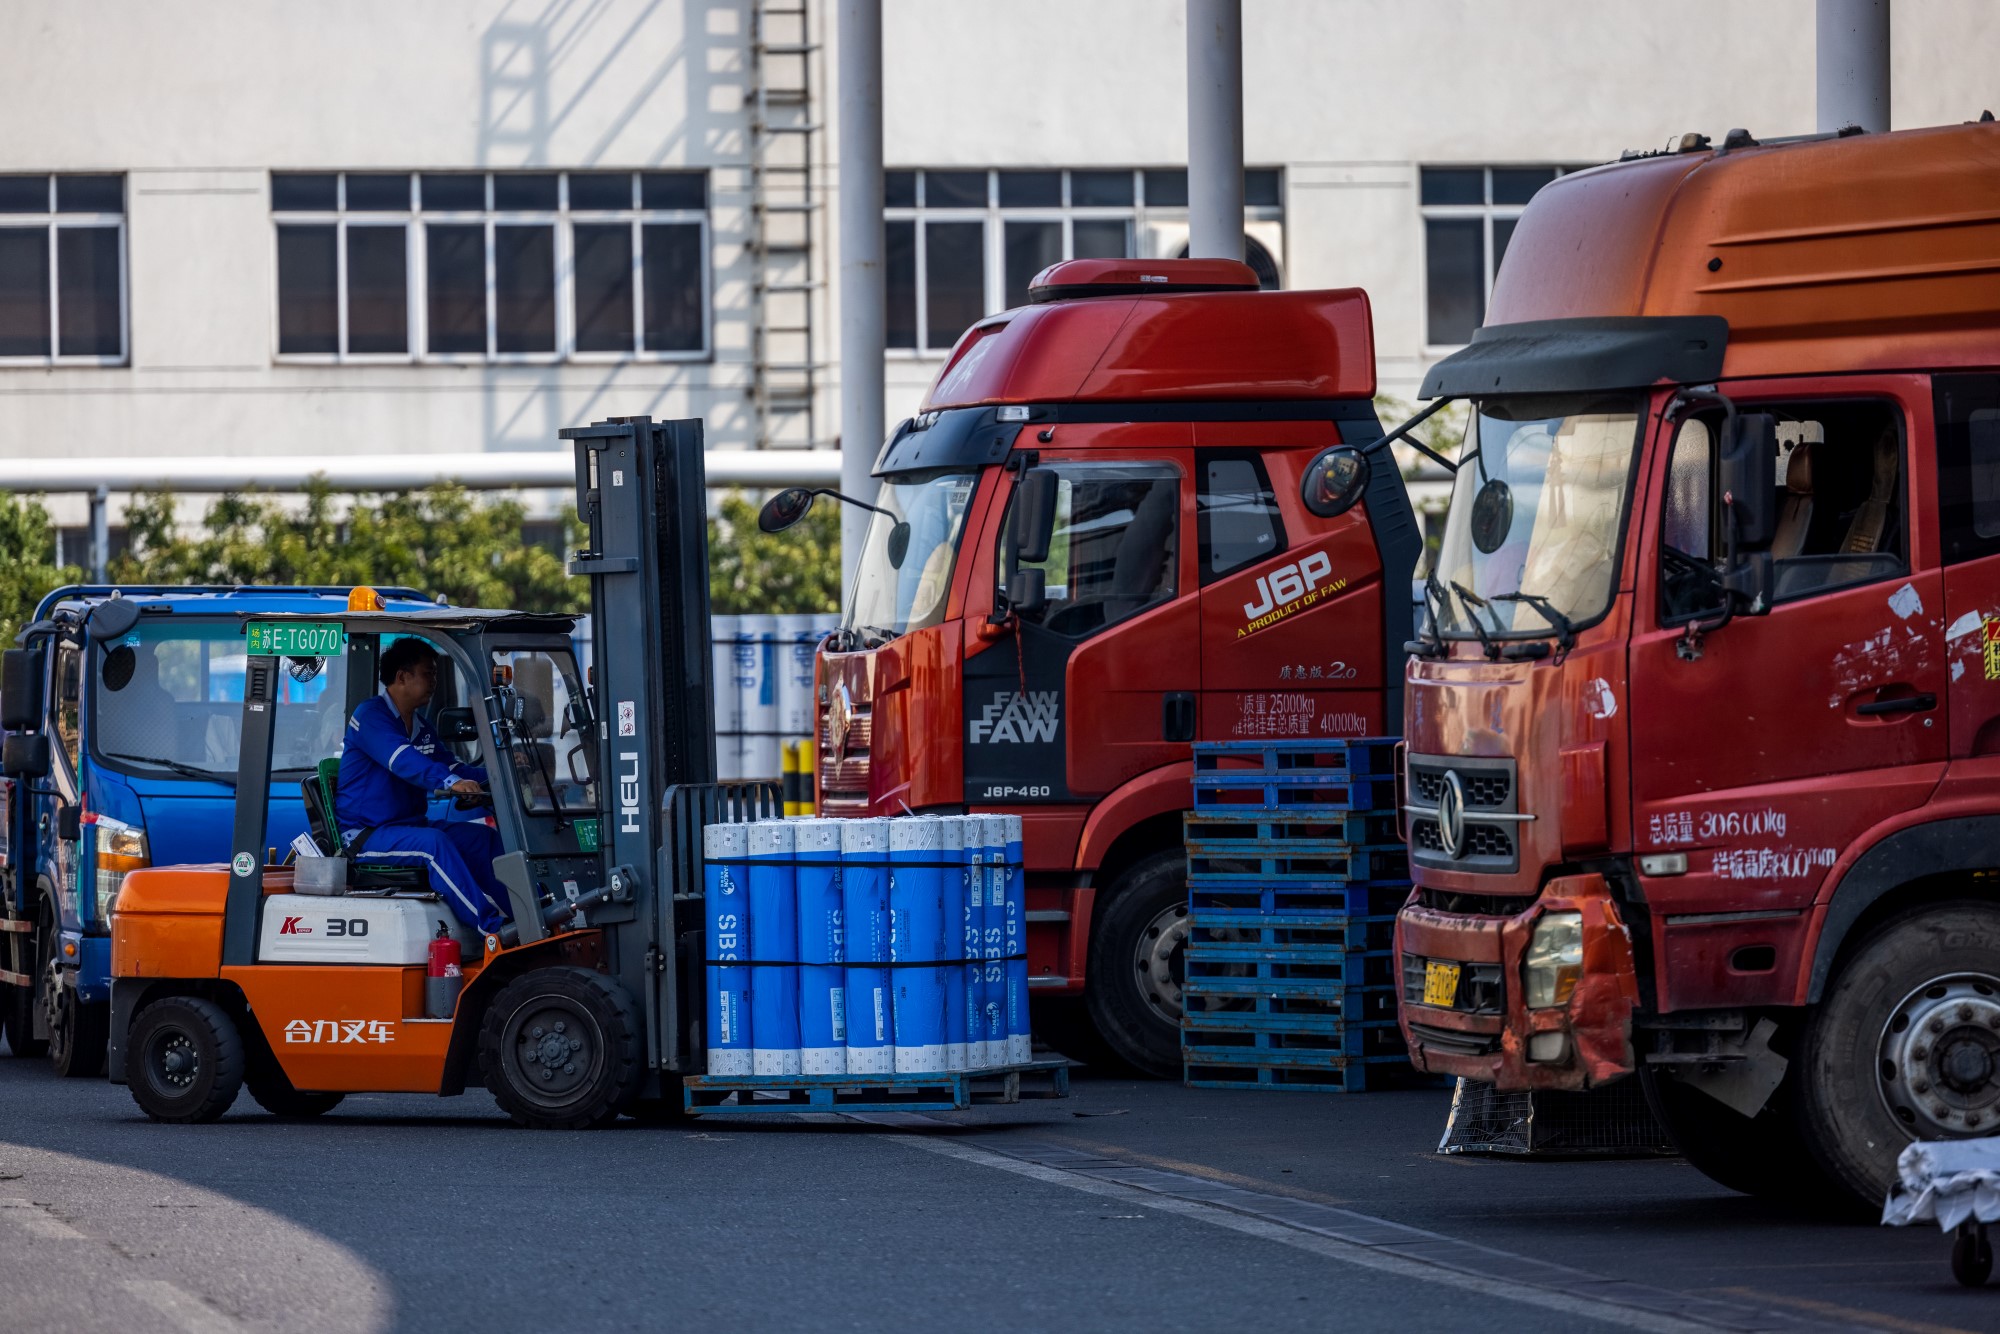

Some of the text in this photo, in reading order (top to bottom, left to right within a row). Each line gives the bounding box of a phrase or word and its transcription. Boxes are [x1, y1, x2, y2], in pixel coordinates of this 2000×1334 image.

[1243, 550, 1332, 620] J6P
[1237, 578, 1348, 639] A PRODUCT OF FAW
[1327, 661, 1357, 679] 2.0
[994, 691, 1058, 708] FAW
[1236, 694, 1315, 718] 质量 25000kg
[983, 704, 1059, 724] FAW
[1320, 713, 1366, 736] 40000kg
[969, 719, 1059, 743] FAW
[620, 752, 639, 832] HELI
[983, 785, 1050, 797] J6P-460
[1649, 811, 1694, 844] 总质量
[279, 916, 303, 934] K
[326, 918, 368, 936] 30
[718, 914, 737, 969] SBS
[985, 927, 1001, 982] SBS
[284, 1019, 395, 1043] 合力叉车
